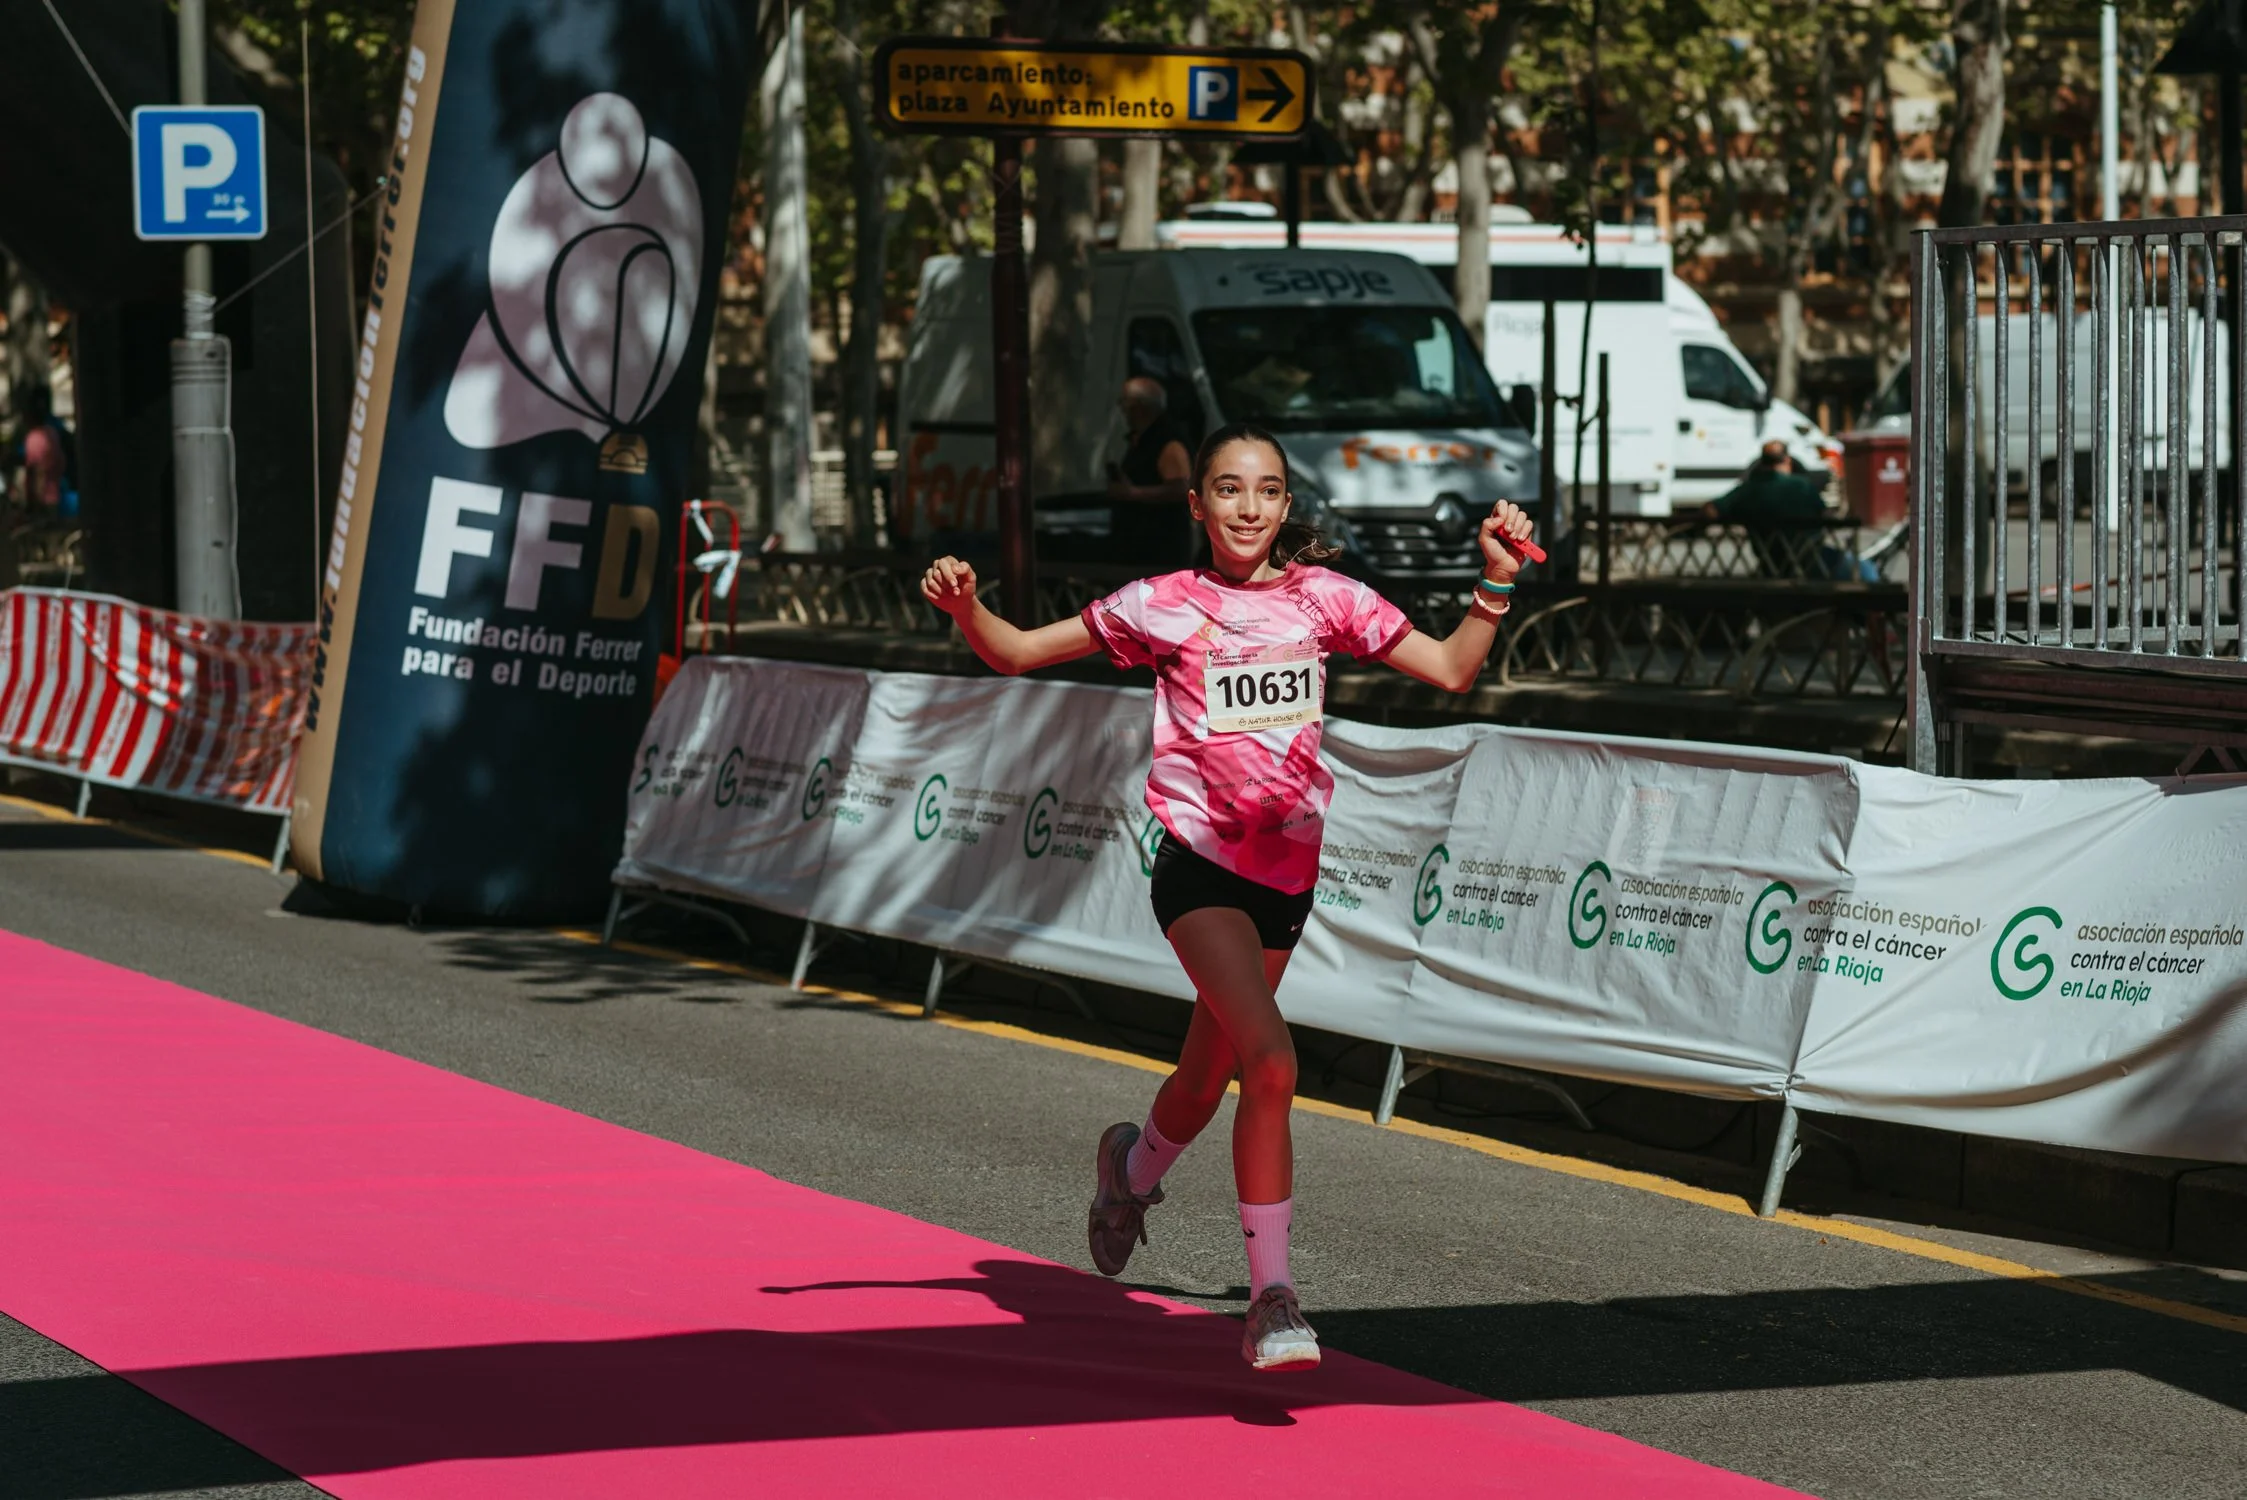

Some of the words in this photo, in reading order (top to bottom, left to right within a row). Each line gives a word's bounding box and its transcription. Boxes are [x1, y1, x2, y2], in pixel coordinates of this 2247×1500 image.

[897, 61, 1093, 86] aparcamiento:
[898, 93, 970, 116] plaza
[987, 91, 1176, 119] Ayuntamiento
[1196, 70, 1232, 117] P
[161, 123, 238, 223] P
[413, 475, 661, 622] FFD
[407, 605, 567, 657] Fundación
[574, 631, 643, 663] Ferrer
[401, 644, 475, 681] para
[490, 658, 523, 688] el
[537, 661, 638, 699] Deporte
[1216, 667, 1311, 708] 10631
[1319, 864, 1347, 883] ontra
[1348, 868, 1361, 885] el
[1458, 859, 1514, 879] asociación
[1516, 865, 1567, 887] española
[1452, 882, 1489, 901] contra
[1488, 886, 1499, 903] el
[1500, 887, 1539, 908] cáncer
[1621, 876, 1688, 899] asociación
[1688, 885, 1745, 908] española
[1446, 909, 1460, 923] en
[1461, 908, 1476, 928] La
[1478, 911, 1505, 934] Rioja
[1615, 901, 1657, 923] contra
[1659, 904, 1672, 925] el
[1672, 908, 1713, 931] cáncer
[1808, 897, 1895, 926] asociación
[1898, 913, 1988, 938] español
[1609, 930, 1624, 947] en
[1626, 927, 1644, 950] La
[1645, 931, 1677, 959] Rioja
[1803, 925, 1848, 948] contra
[1852, 929, 1872, 950] el
[1874, 934, 1947, 961] cáncer
[2077, 921, 2166, 945] asociación
[2169, 923, 2245, 950] española
[1834, 955, 1884, 986] Rioja
[2070, 949, 2126, 972] contra
[2128, 950, 2146, 972] el
[2147, 951, 2206, 975] cáncer
[2060, 978, 2084, 998] en
[2085, 977, 2108, 1000] La
[2110, 978, 2152, 1007] Rioja
